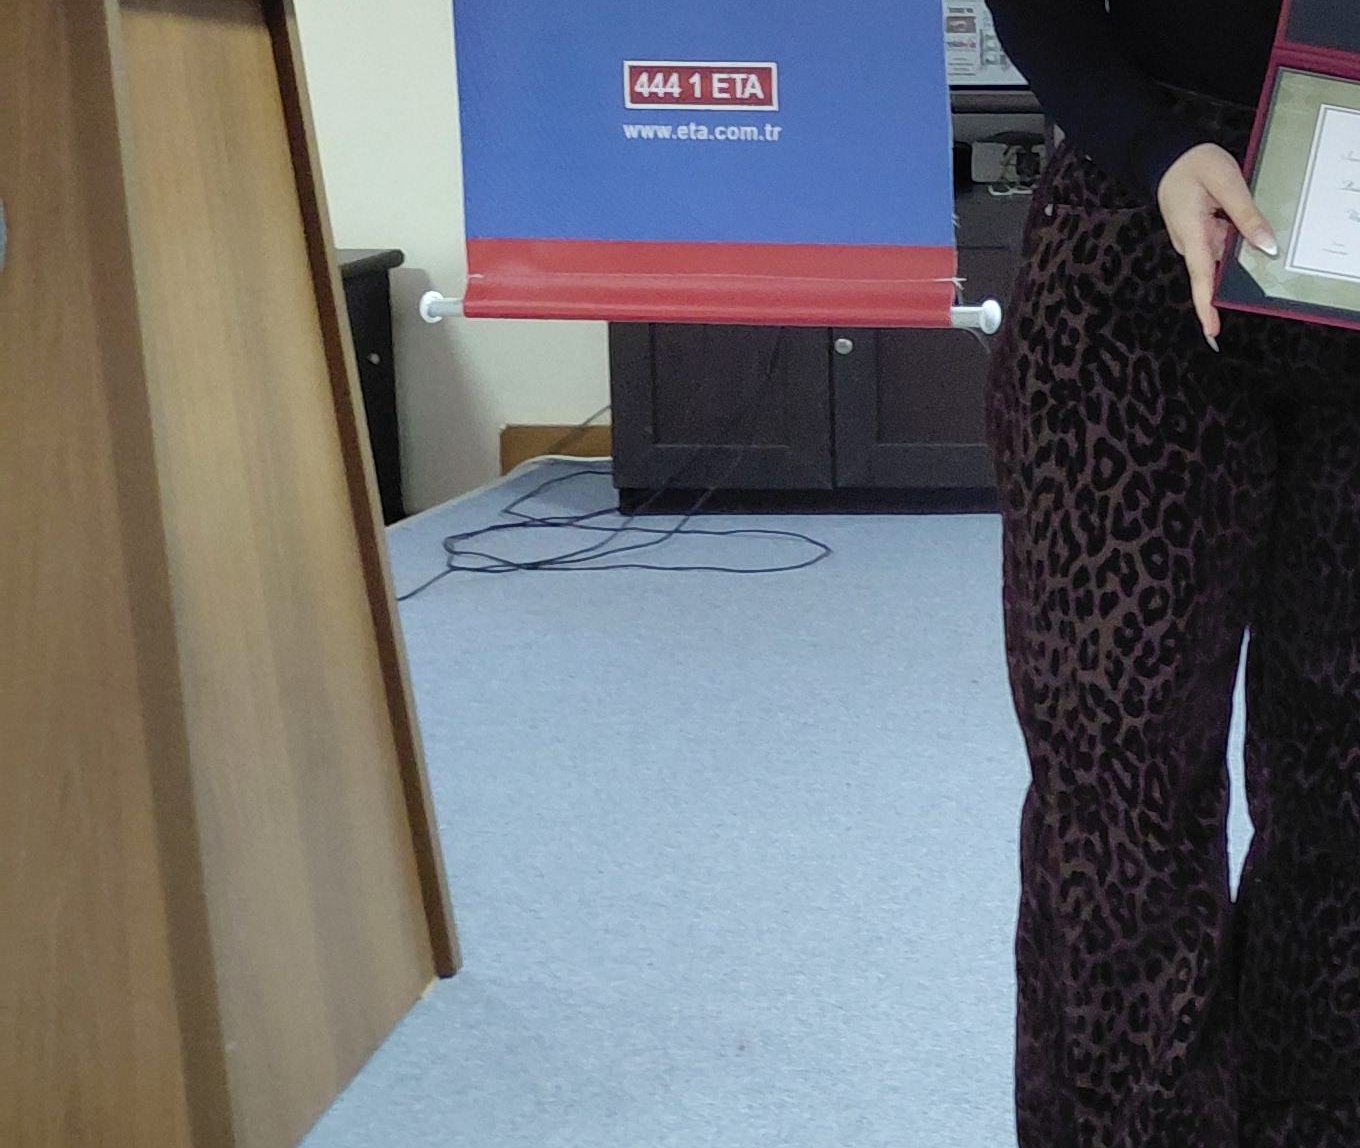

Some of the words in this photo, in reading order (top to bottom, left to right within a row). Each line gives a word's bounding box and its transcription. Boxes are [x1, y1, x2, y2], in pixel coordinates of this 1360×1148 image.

[634, 71, 682, 98] 444
[688, 71, 701, 99] 1
[711, 72, 765, 100] ETA
[622, 122, 783, 142] www.eta.com.tr
